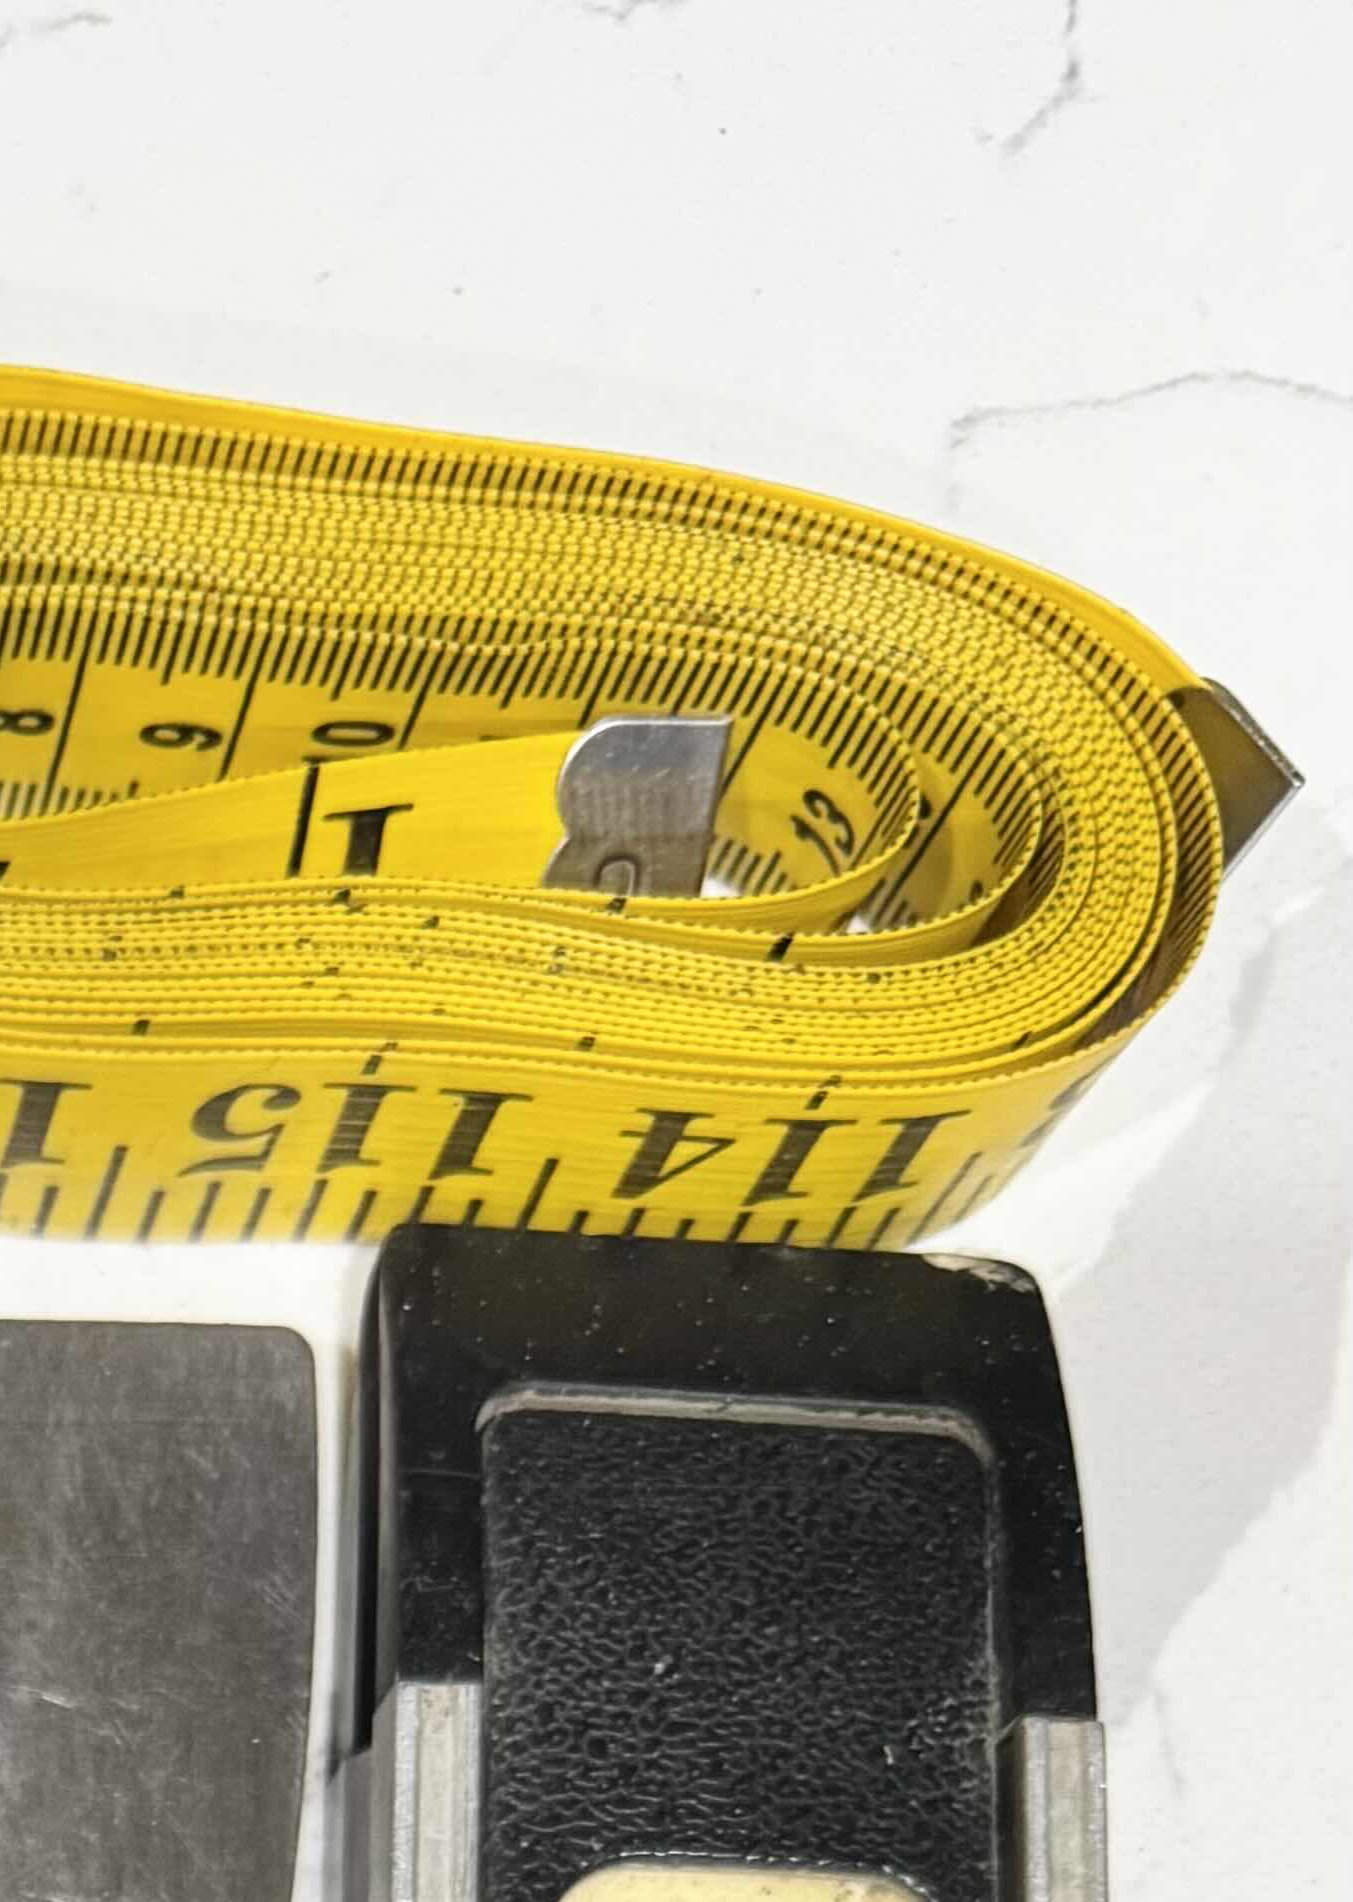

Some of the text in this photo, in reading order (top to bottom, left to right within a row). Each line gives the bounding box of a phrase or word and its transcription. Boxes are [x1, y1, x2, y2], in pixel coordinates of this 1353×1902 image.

[138, 721, 224, 752] 9
[790, 789, 855, 877] 13
[179, 1081, 535, 1180] 115
[610, 1106, 973, 1207] 114
